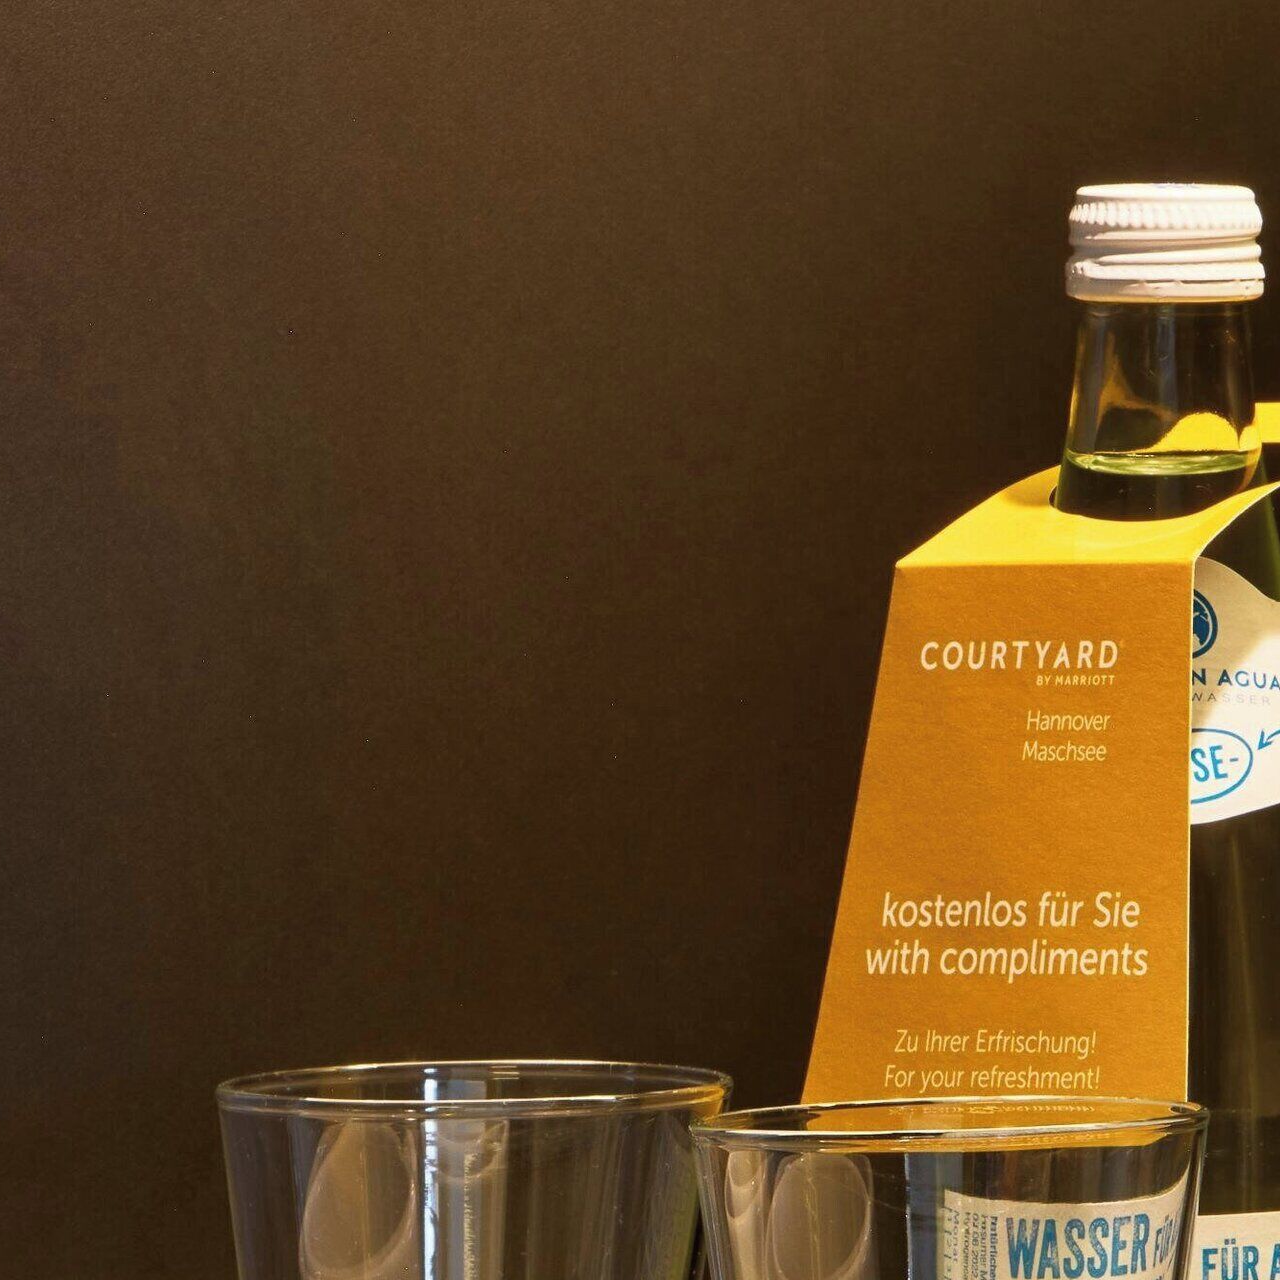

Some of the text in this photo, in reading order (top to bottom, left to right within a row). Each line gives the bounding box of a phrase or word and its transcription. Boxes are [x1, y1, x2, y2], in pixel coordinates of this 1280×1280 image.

[920, 640, 1119, 671] COURTYARD
[1036, 675, 1116, 687] BY MARRIOTT
[1027, 710, 1112, 732] Hannover
[1022, 741, 1108, 762] Maschsee
[882, 891, 1141, 928] kostenlos für Sie
[866, 938, 1149, 985] with compliments
[895, 1029, 1098, 1060] Zu Ihrer Erfrischung!
[884, 1065, 1101, 1094] For your refreshment!
[1006, 1213, 1150, 1280] WASSER
